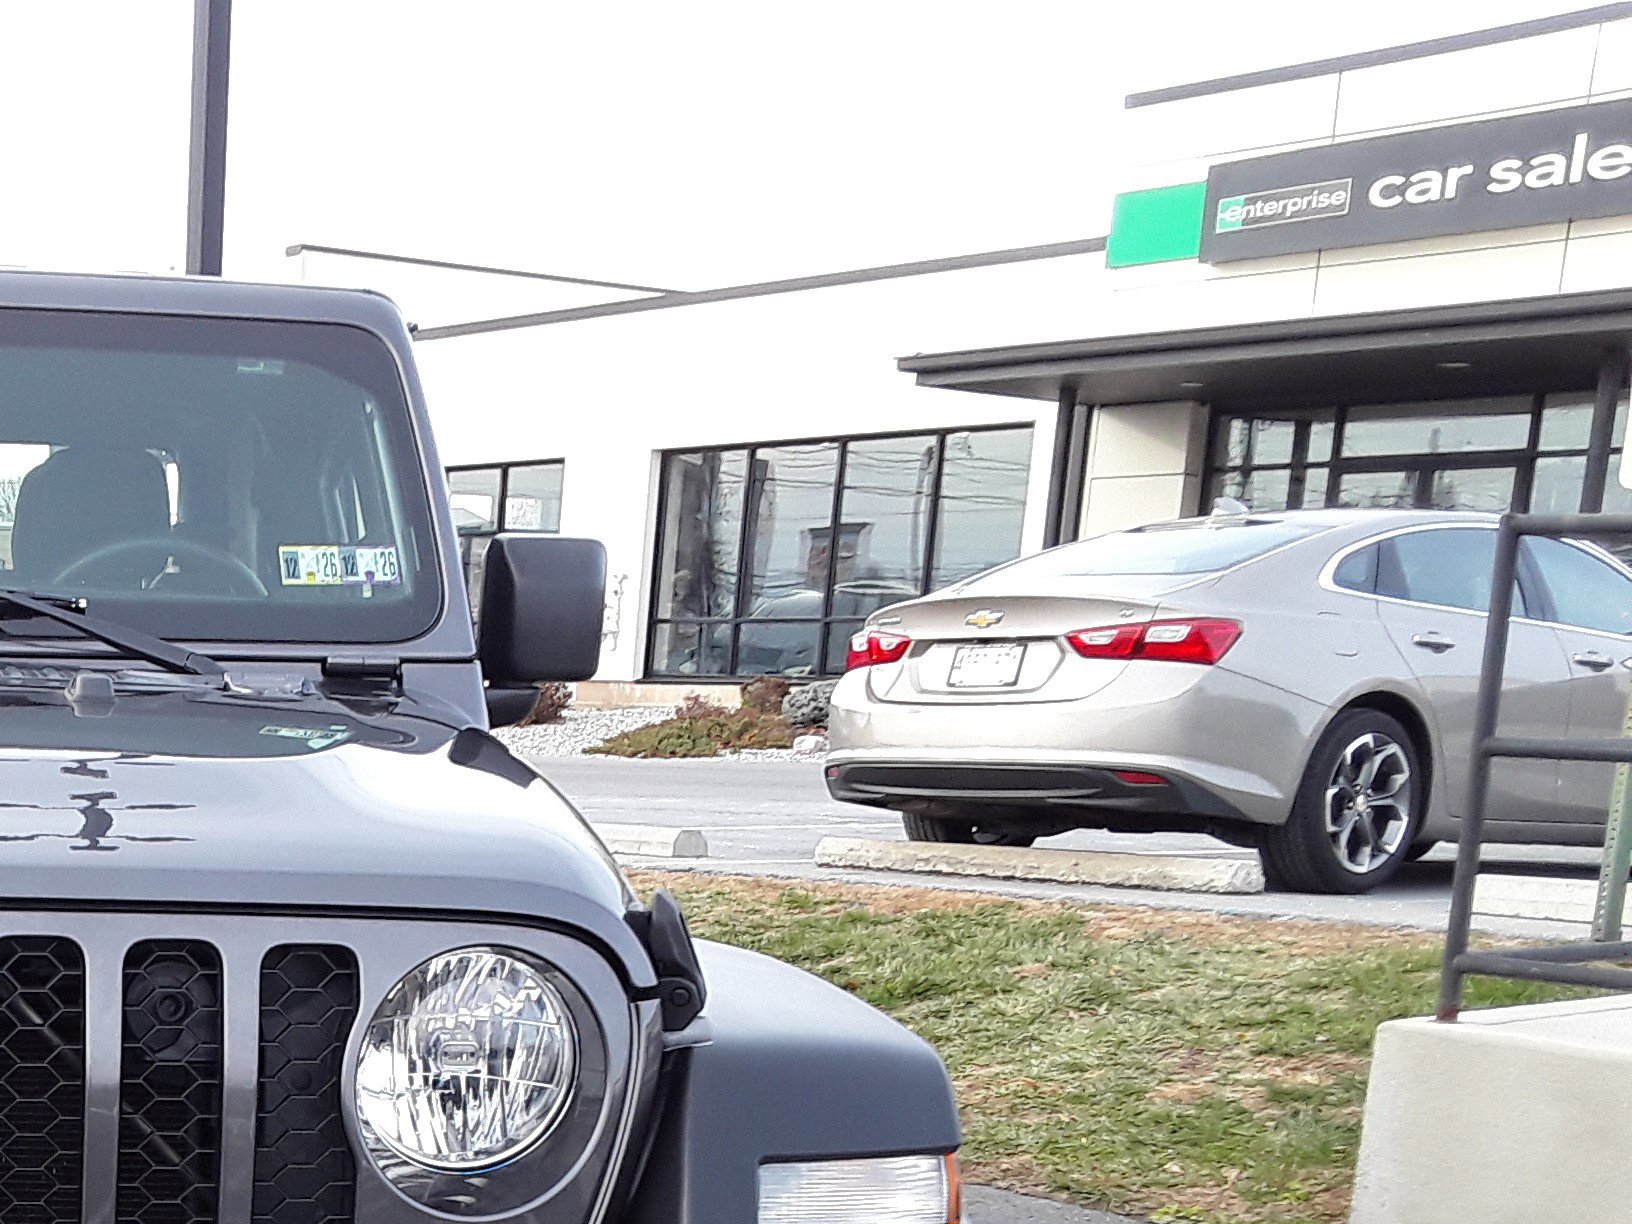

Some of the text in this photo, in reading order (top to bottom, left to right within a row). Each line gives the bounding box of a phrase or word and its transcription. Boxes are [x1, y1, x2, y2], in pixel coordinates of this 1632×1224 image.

[1221, 133, 1632, 221] enterprise car sale
